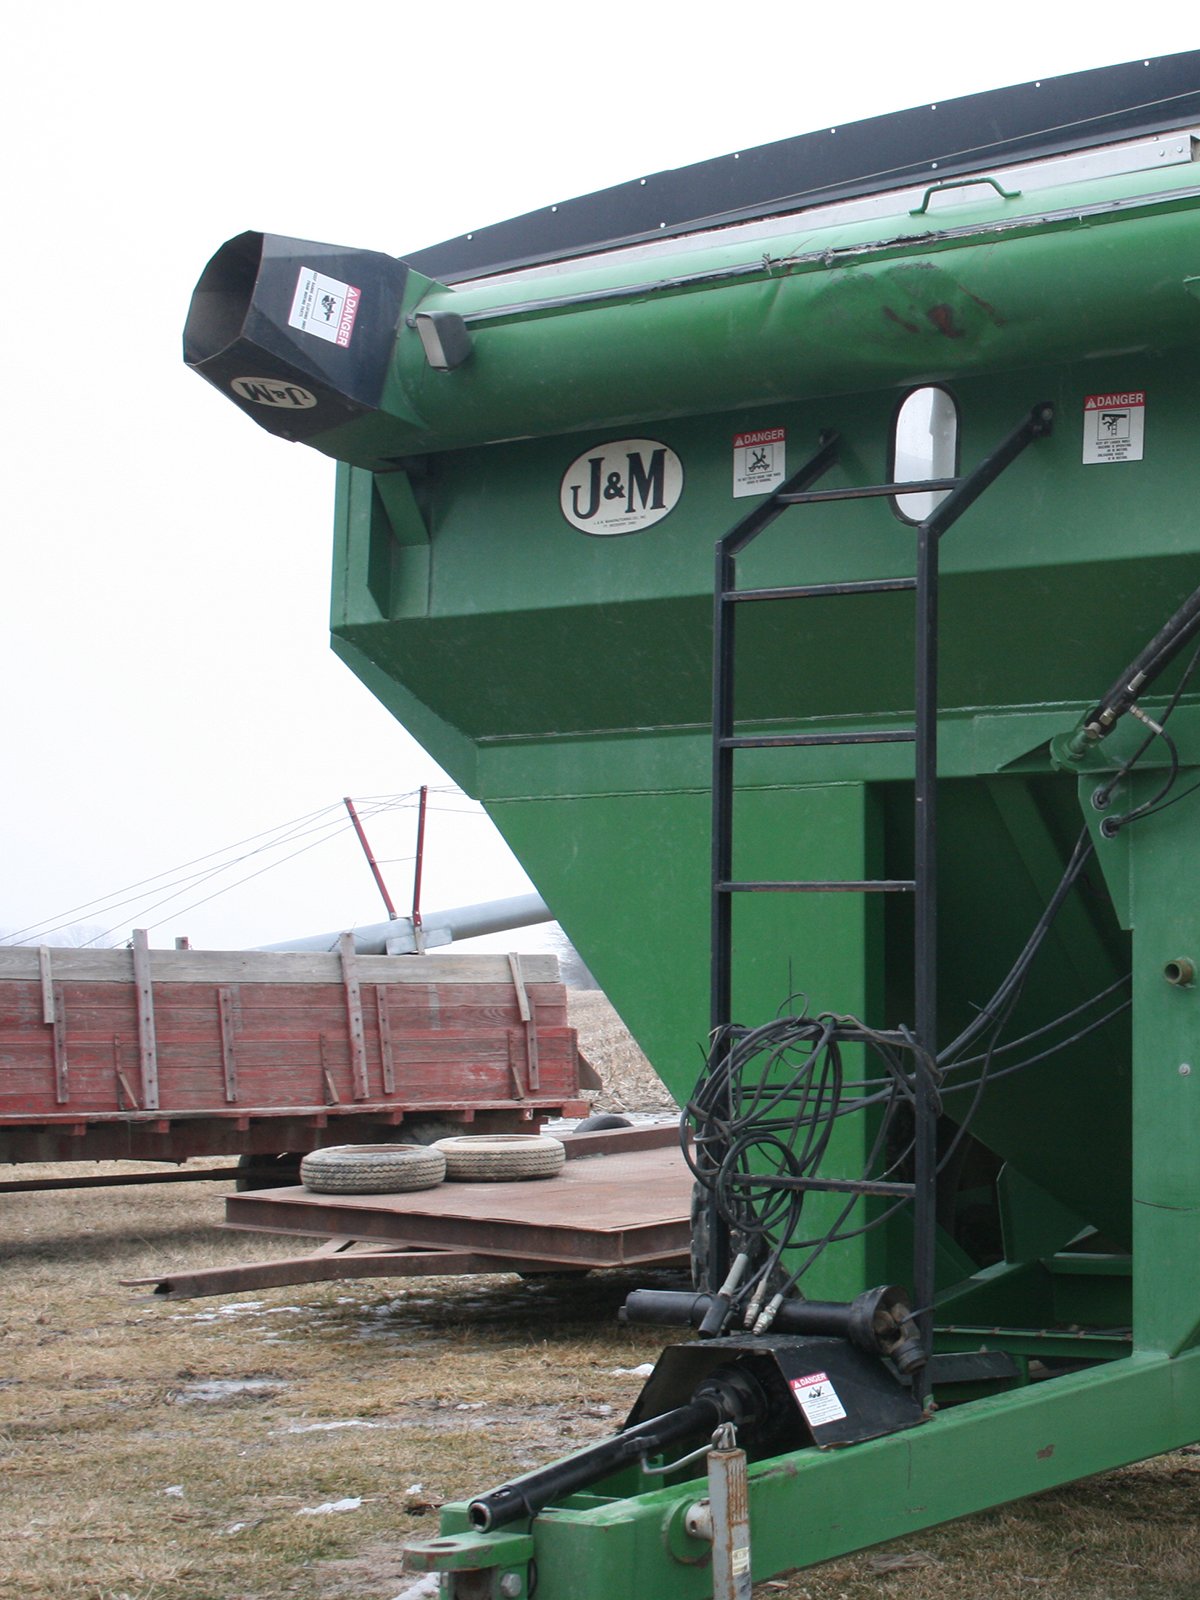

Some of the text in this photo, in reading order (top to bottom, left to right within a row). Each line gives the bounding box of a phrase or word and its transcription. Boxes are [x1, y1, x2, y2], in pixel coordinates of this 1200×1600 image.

[337, 298, 356, 346] DANGER
[238, 382, 310, 406] J&M
[1097, 394, 1144, 406] DANGER
[744, 429, 785, 444] DANGER
[570, 448, 668, 519] J&M
[800, 1374, 827, 1385] DANGER
